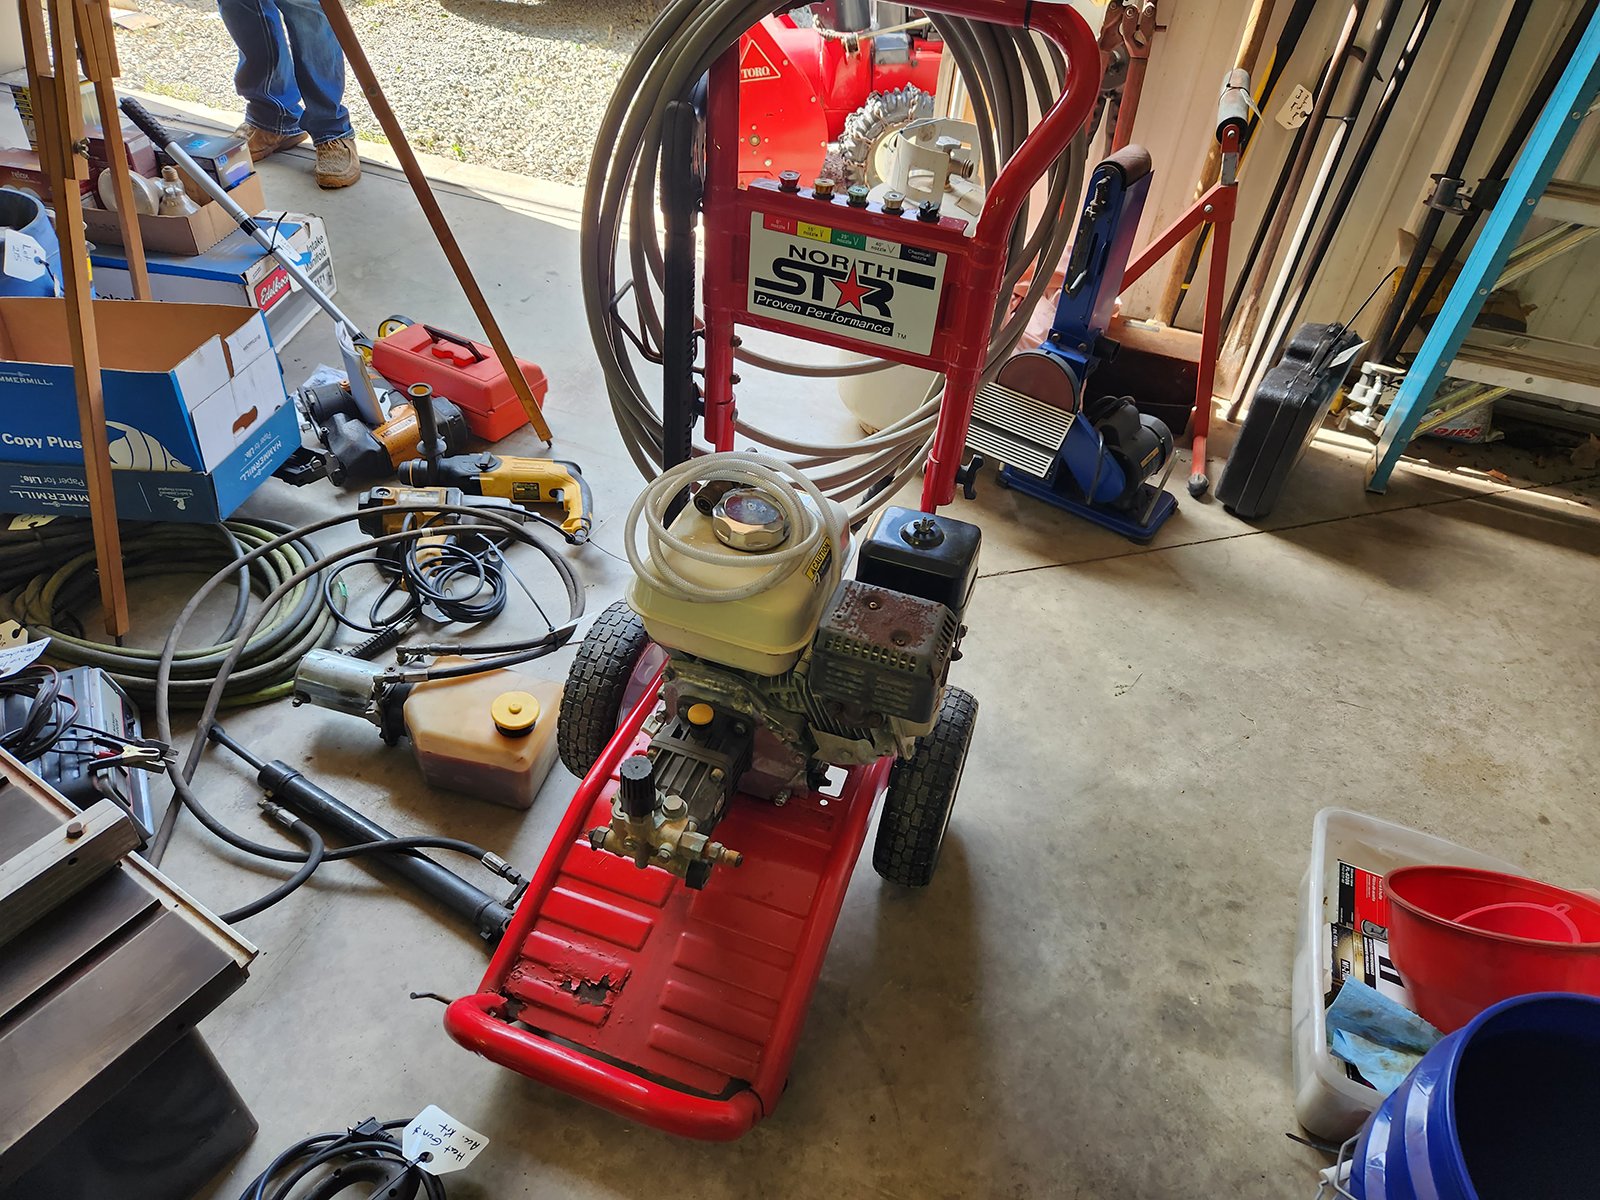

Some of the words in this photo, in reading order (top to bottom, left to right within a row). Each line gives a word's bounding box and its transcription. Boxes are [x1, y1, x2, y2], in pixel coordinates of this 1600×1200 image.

[743, 66, 770, 78] TORO
[307, 235, 324, 253] Intake
[305, 245, 327, 273] Manifold
[789, 244, 895, 280] NORTH
[756, 294, 802, 314] Proven
[805, 306, 892, 335] Performance
[2, 433, 42, 449] Copy
[46, 435, 83, 449] Plus
[44, 476, 58, 485] for
[60, 477, 86, 487] Paper
[812, 542, 831, 570] CAUTION
[422, 1129, 443, 1146] Gun
[438, 1123, 457, 1138] Kit
[443, 1145, 466, 1162] Heat
